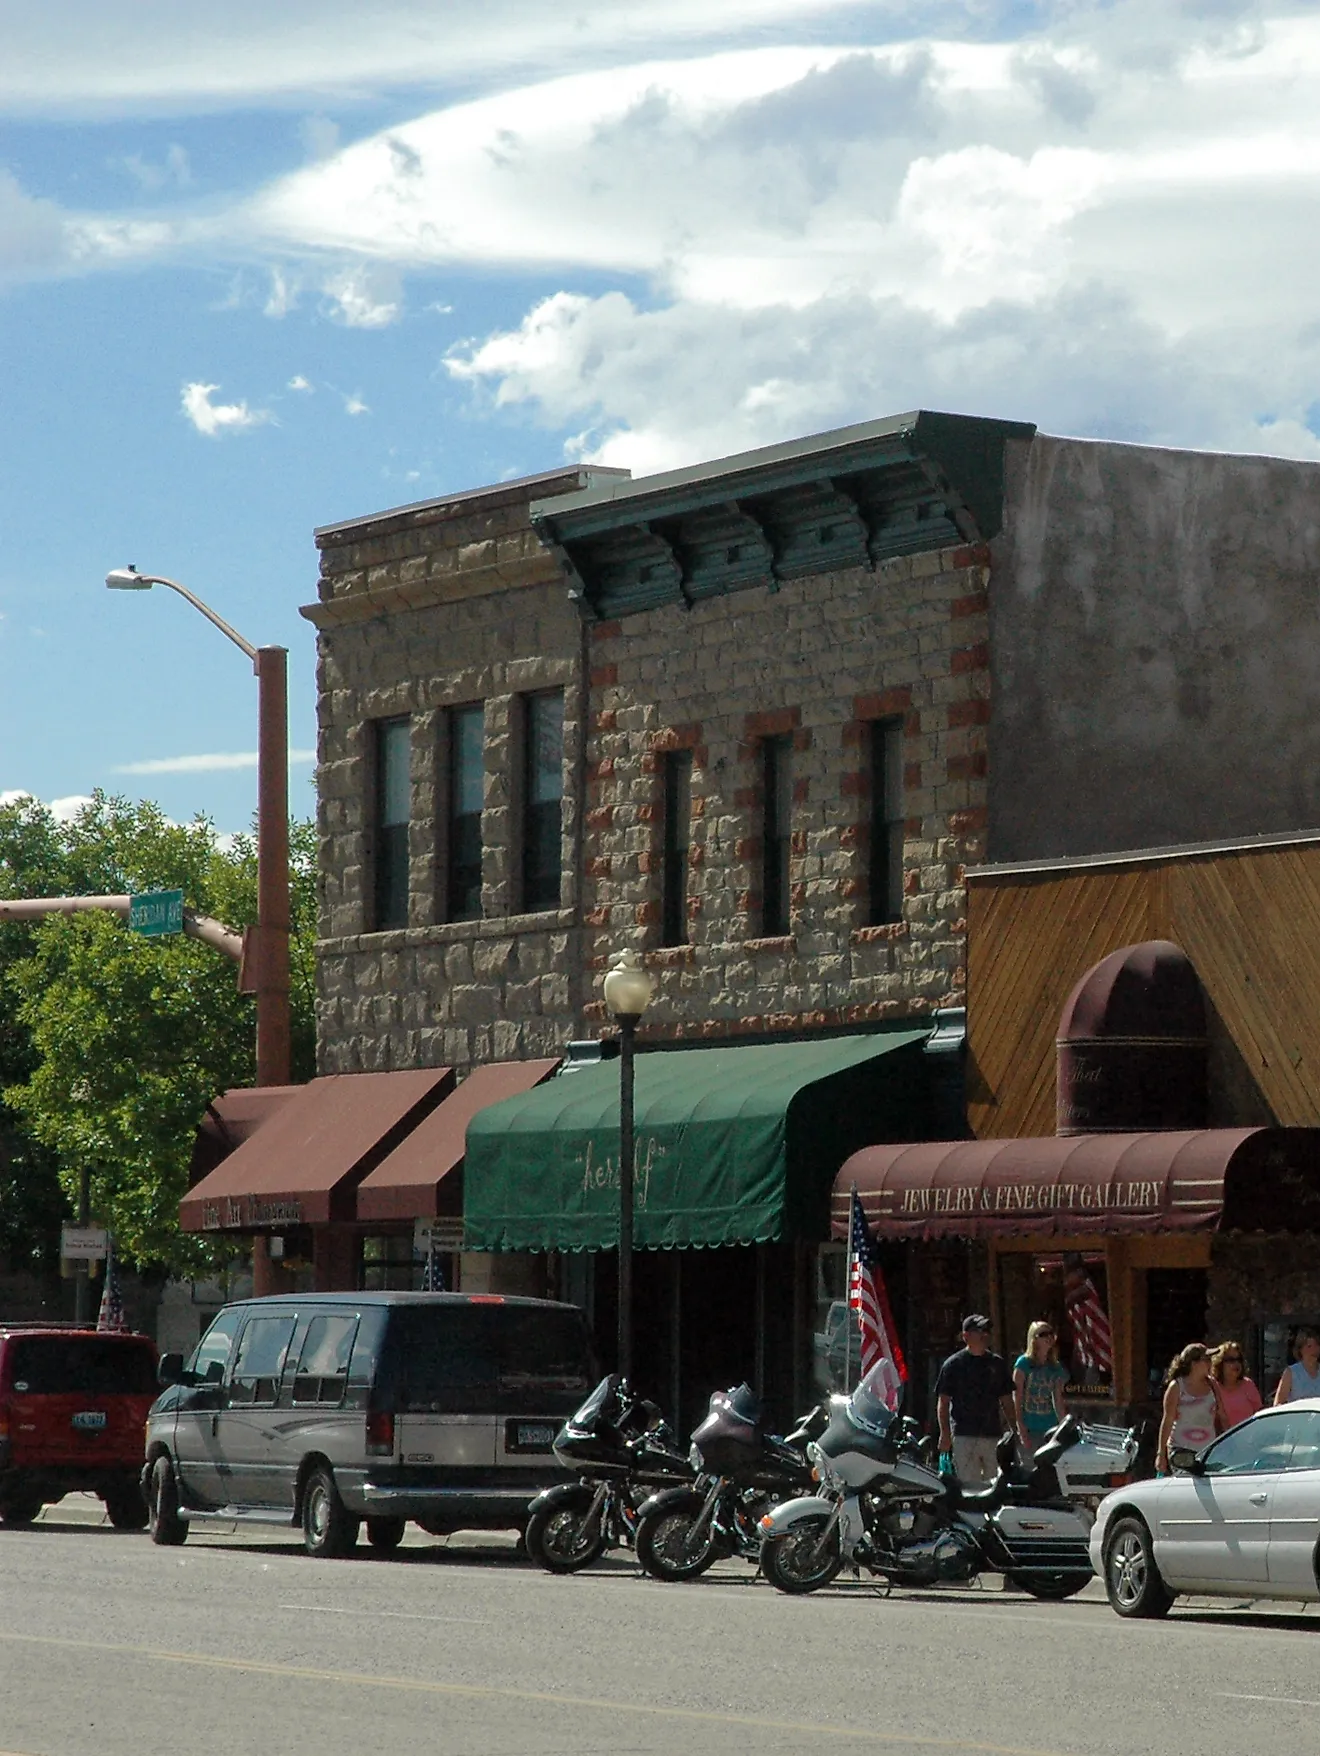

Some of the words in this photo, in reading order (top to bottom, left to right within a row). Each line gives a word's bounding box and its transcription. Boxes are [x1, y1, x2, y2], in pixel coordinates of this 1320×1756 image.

[900, 1187, 978, 1213] JEWELRY
[980, 1187, 990, 1210] &
[994, 1185, 1036, 1210] FINE
[1037, 1183, 1079, 1209] GIFT
[1080, 1181, 1164, 1209] GALLERY
